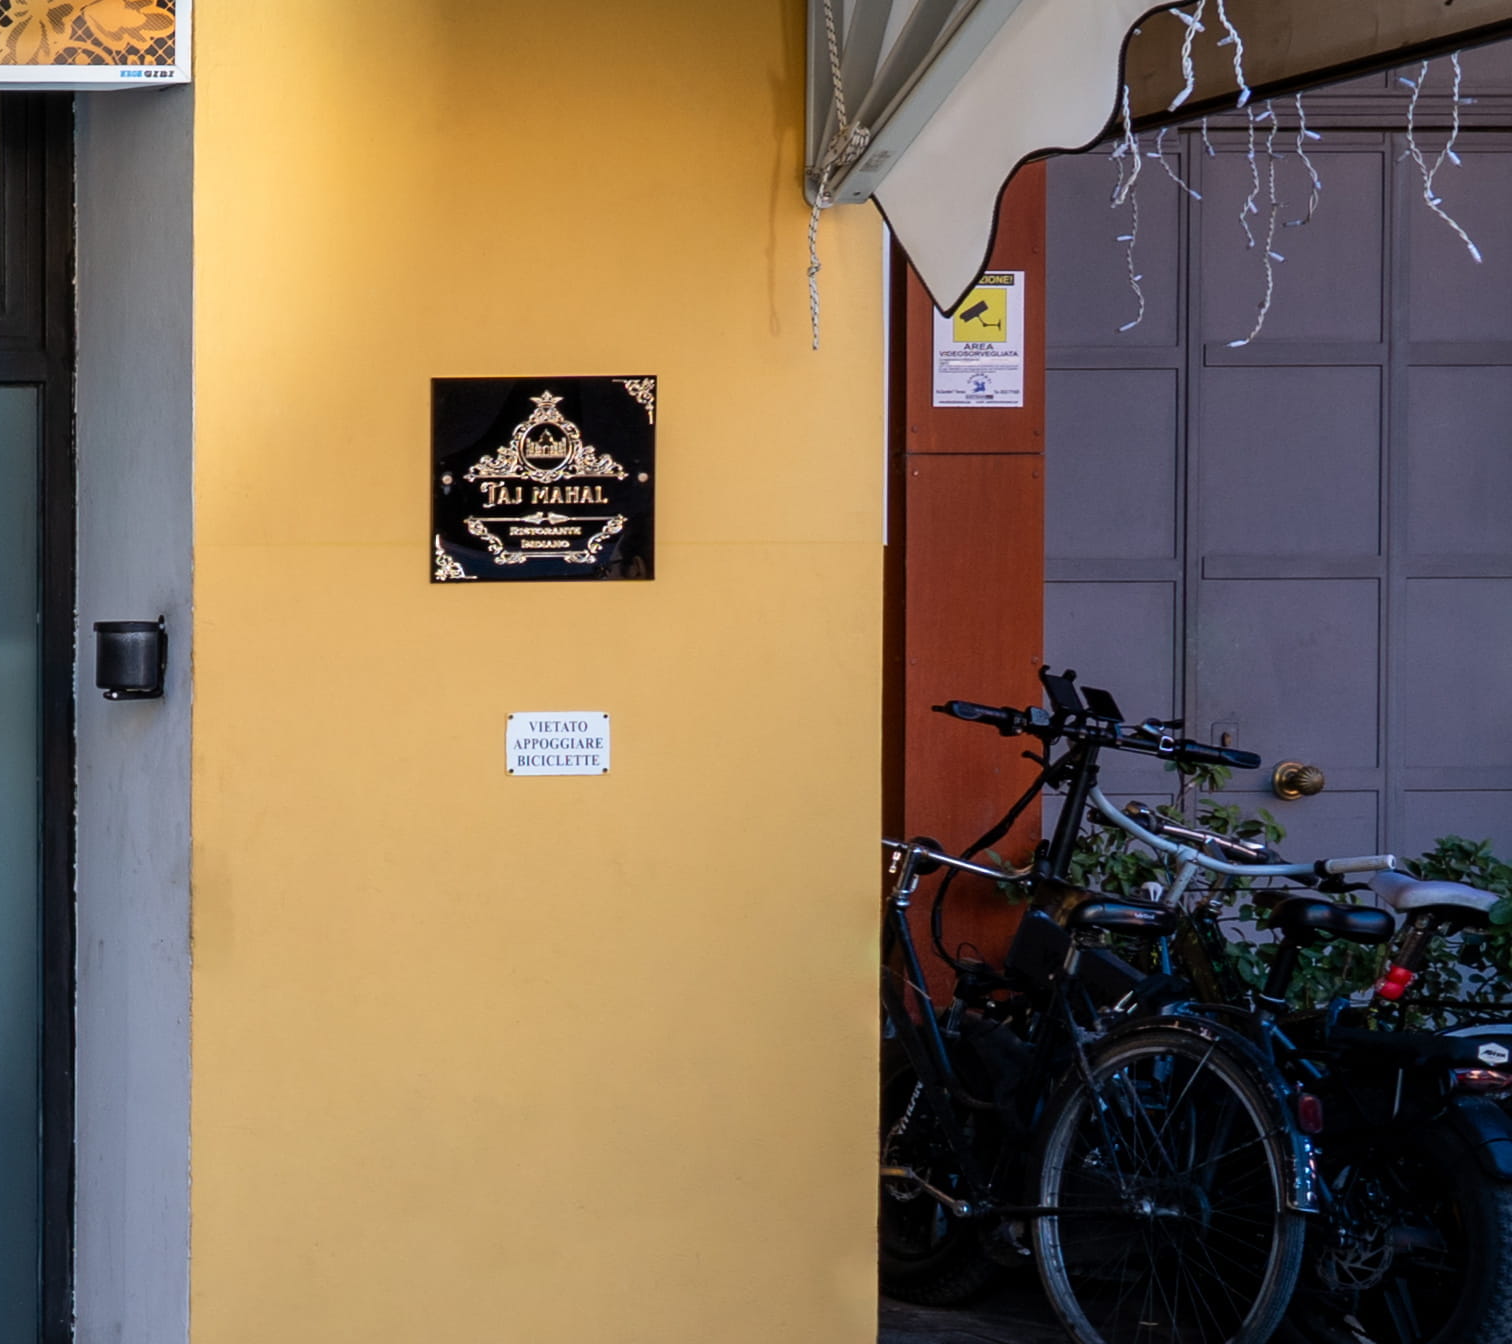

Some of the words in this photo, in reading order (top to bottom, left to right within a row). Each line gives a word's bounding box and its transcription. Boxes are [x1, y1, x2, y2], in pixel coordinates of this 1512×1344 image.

[978, 274, 1013, 285] ZIONE!
[964, 342, 994, 351] AREA
[480, 481, 523, 508] TAJ
[531, 485, 609, 505] MAHAL
[509, 526, 582, 536] RISTORANTE
[520, 539, 571, 549] INDIANO
[529, 721, 589, 733] VIETATO
[514, 737, 604, 750] APPOGGIARE
[517, 754, 600, 767] BICICLETTE
